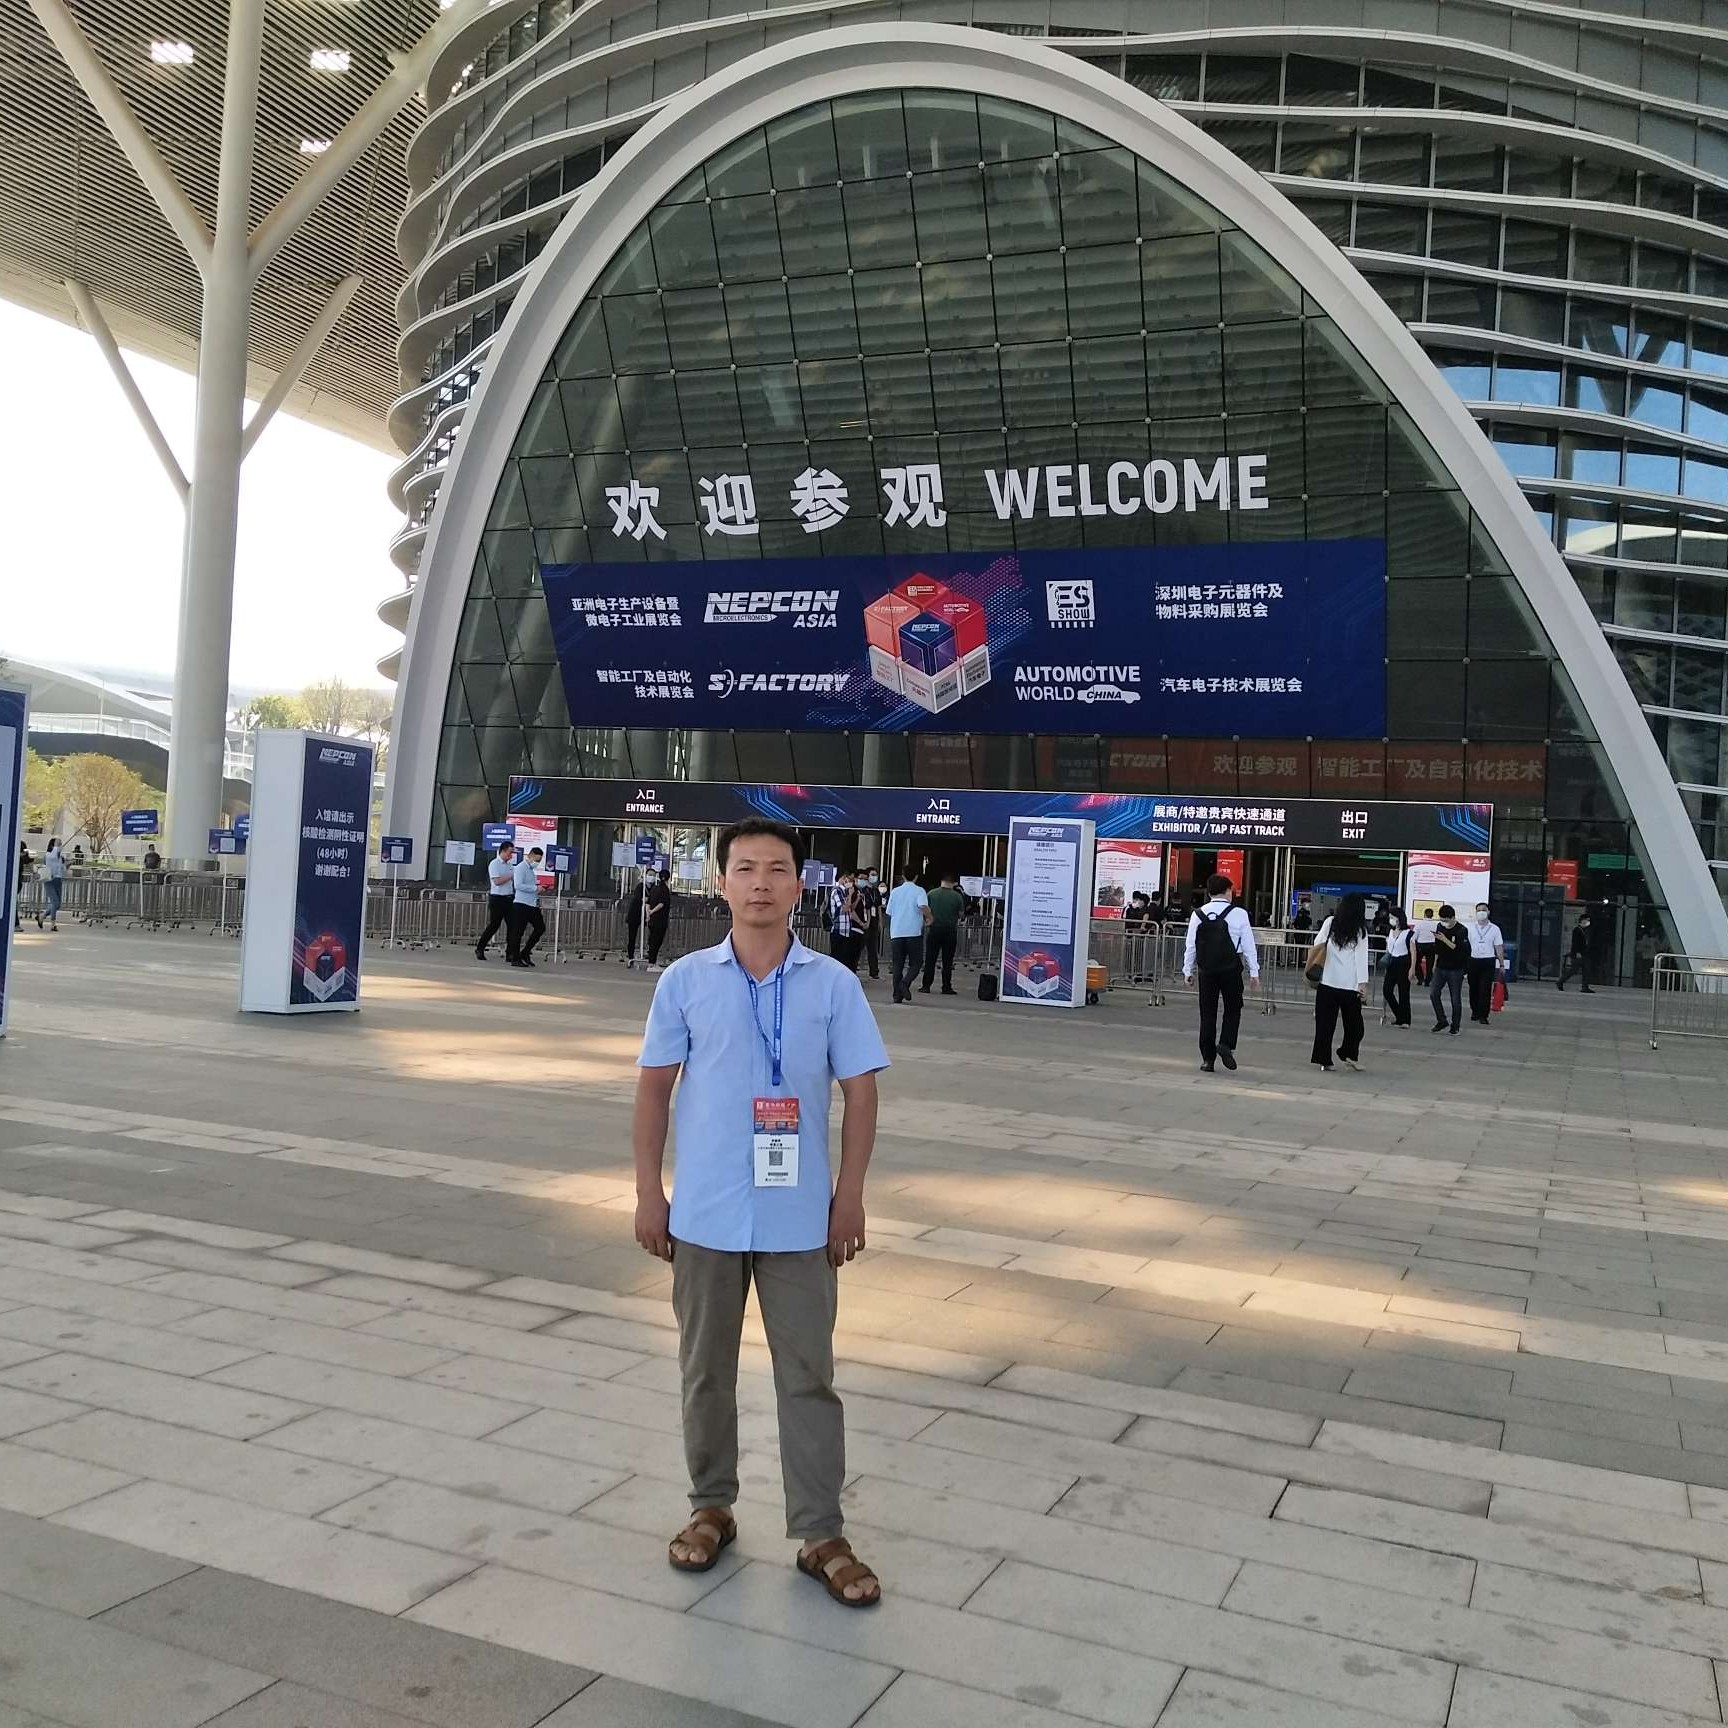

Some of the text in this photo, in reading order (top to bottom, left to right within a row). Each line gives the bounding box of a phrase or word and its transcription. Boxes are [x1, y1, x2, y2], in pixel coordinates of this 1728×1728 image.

[605, 455, 1269, 540] 欢迎参观 WELCOME
[1055, 586, 1090, 608] ES
[1155, 583, 1284, 600] 深圳电子元器件及
[571, 597, 680, 611] 亚洲电子生产设备暨
[704, 591, 839, 616] NEPCON
[1156, 602, 1269, 619] 物料采购展览会
[585, 613, 682, 627] 微电子工业展览会
[713, 614, 769, 622] MICROELECTRONICS
[793, 614, 837, 628] ASIA
[1058, 609, 1090, 619] SHOW
[596, 669, 692, 683] 智能工厂及自动化
[1014, 665, 1141, 682] AUTOMOTIVE
[635, 685, 694, 699] 技术展览会
[1160, 677, 1303, 693] 汽车电子技术展览会
[1015, 686, 1122, 701] WORLD CHINA
[319, 748, 357, 760] NEPCON
[636, 789, 656, 801] 入口
[625, 802, 664, 814] ENTRANCE
[928, 798, 950, 810] 入口
[316, 808, 355, 824] 入馆请出示
[916, 813, 960, 825] ENTRANCE
[1153, 805, 1286, 822] 展商/特邀贵宾快速通道
[1341, 810, 1368, 824] 出口
[1152, 822, 1201, 834] EXHIBITOR
[1210, 824, 1227, 834] TAP
[1230, 825, 1252, 836] FAST
[1254, 825, 1285, 837] TRACK
[1343, 828, 1365, 839] EXIT
